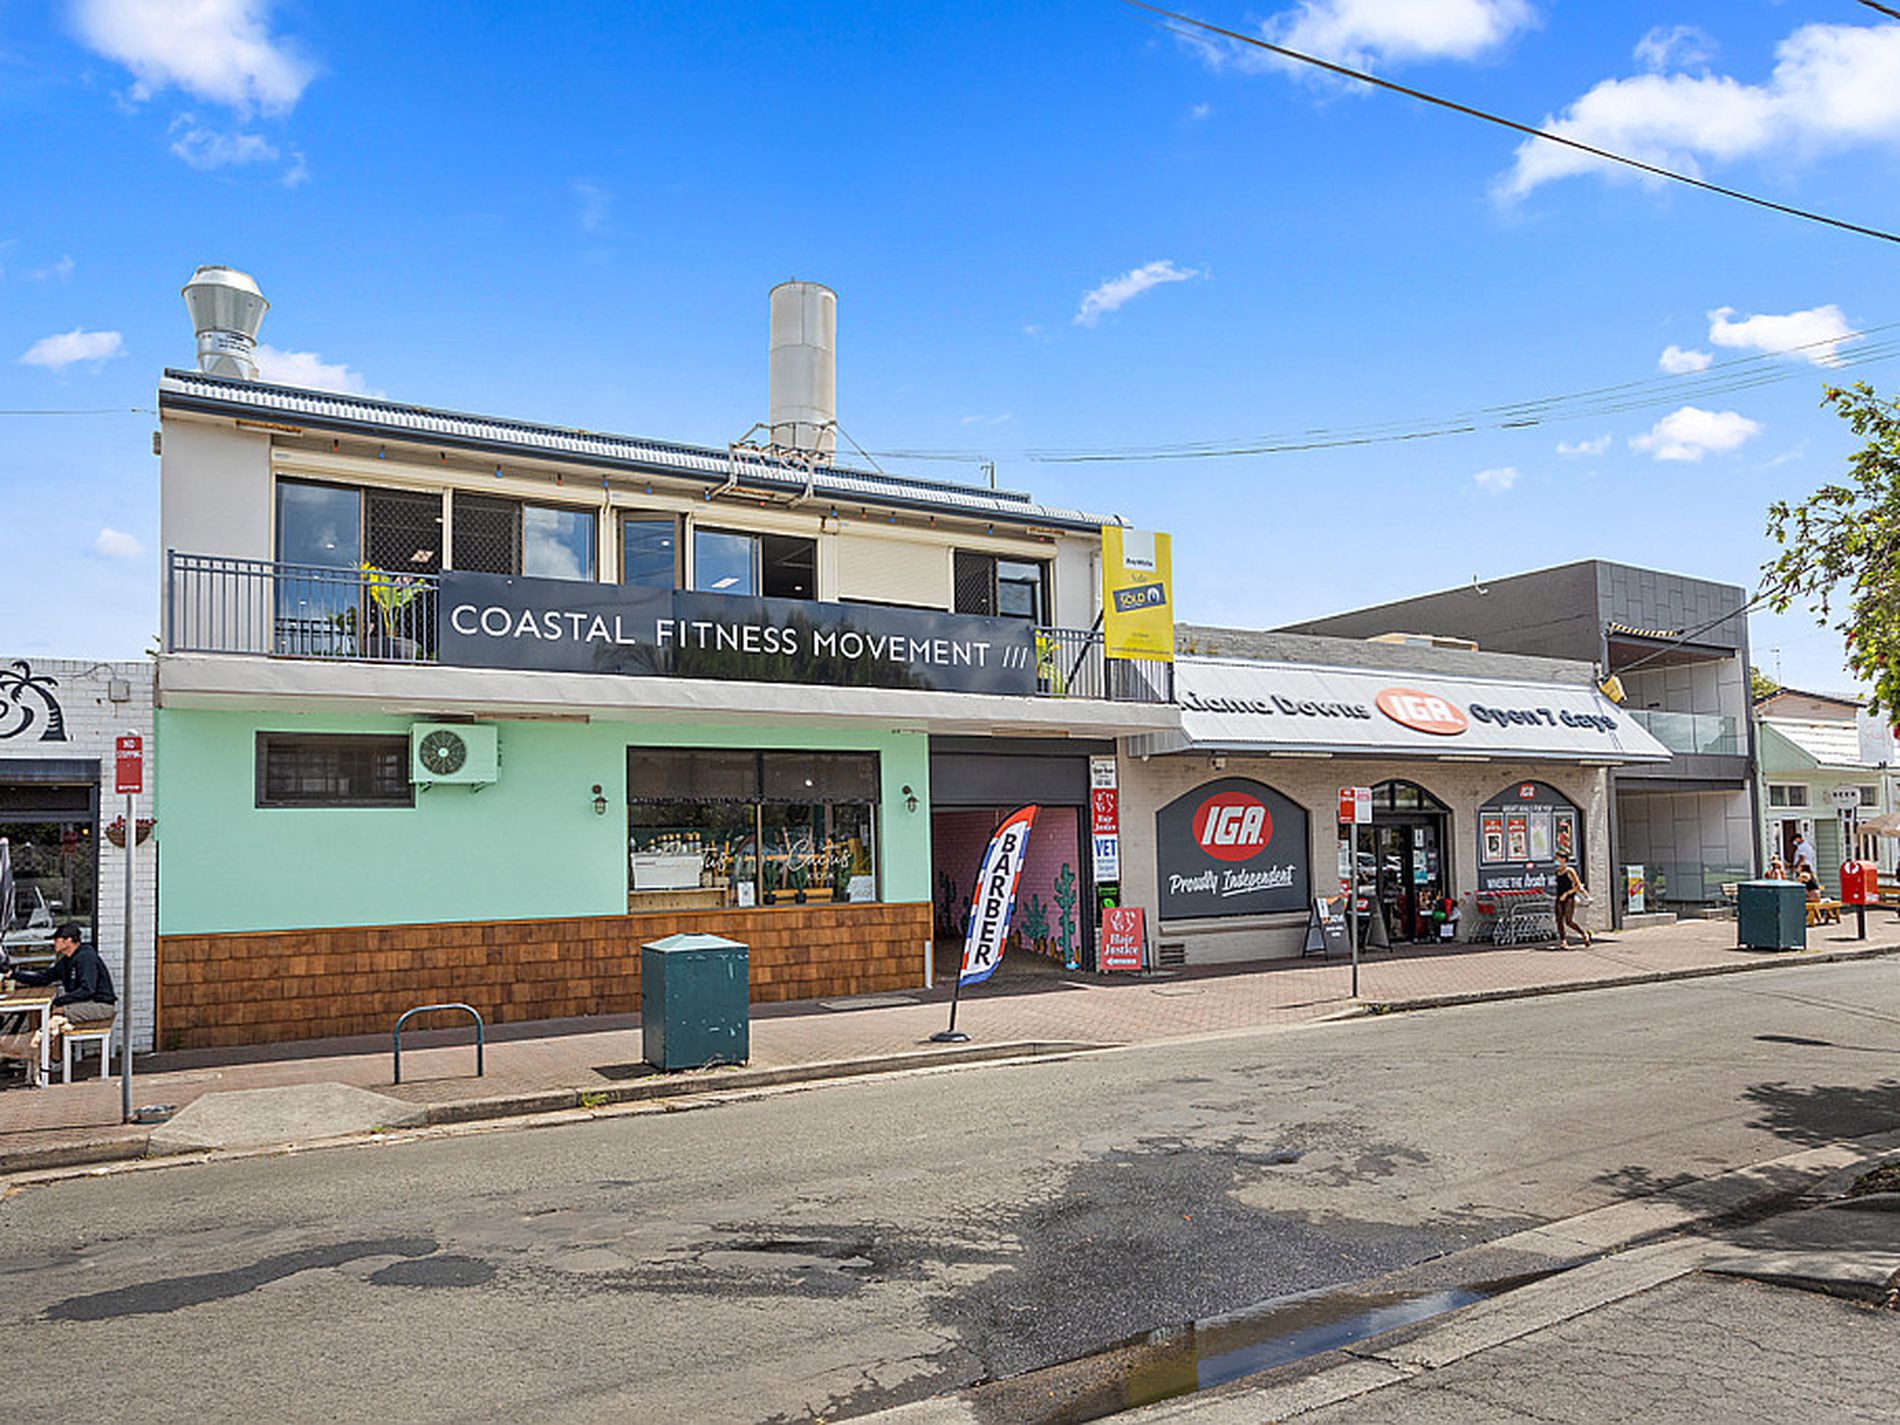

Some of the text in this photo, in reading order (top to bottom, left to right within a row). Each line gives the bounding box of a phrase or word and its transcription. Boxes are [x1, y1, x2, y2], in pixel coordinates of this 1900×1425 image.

[450, 604, 636, 645] COASTAL
[655, 618, 798, 655] FITNESS
[813, 629, 991, 668] MOVEMENT
[1271, 694, 1372, 720] Downs
[1388, 694, 1464, 725] IGA
[1469, 703, 1542, 728] Open
[1559, 709, 1619, 733] days
[1201, 805, 1266, 846] IGA
[1094, 838, 1118, 857] VET
[1168, 864, 1297, 895] Proudly Independent
[974, 833, 1017, 966] BARBER
